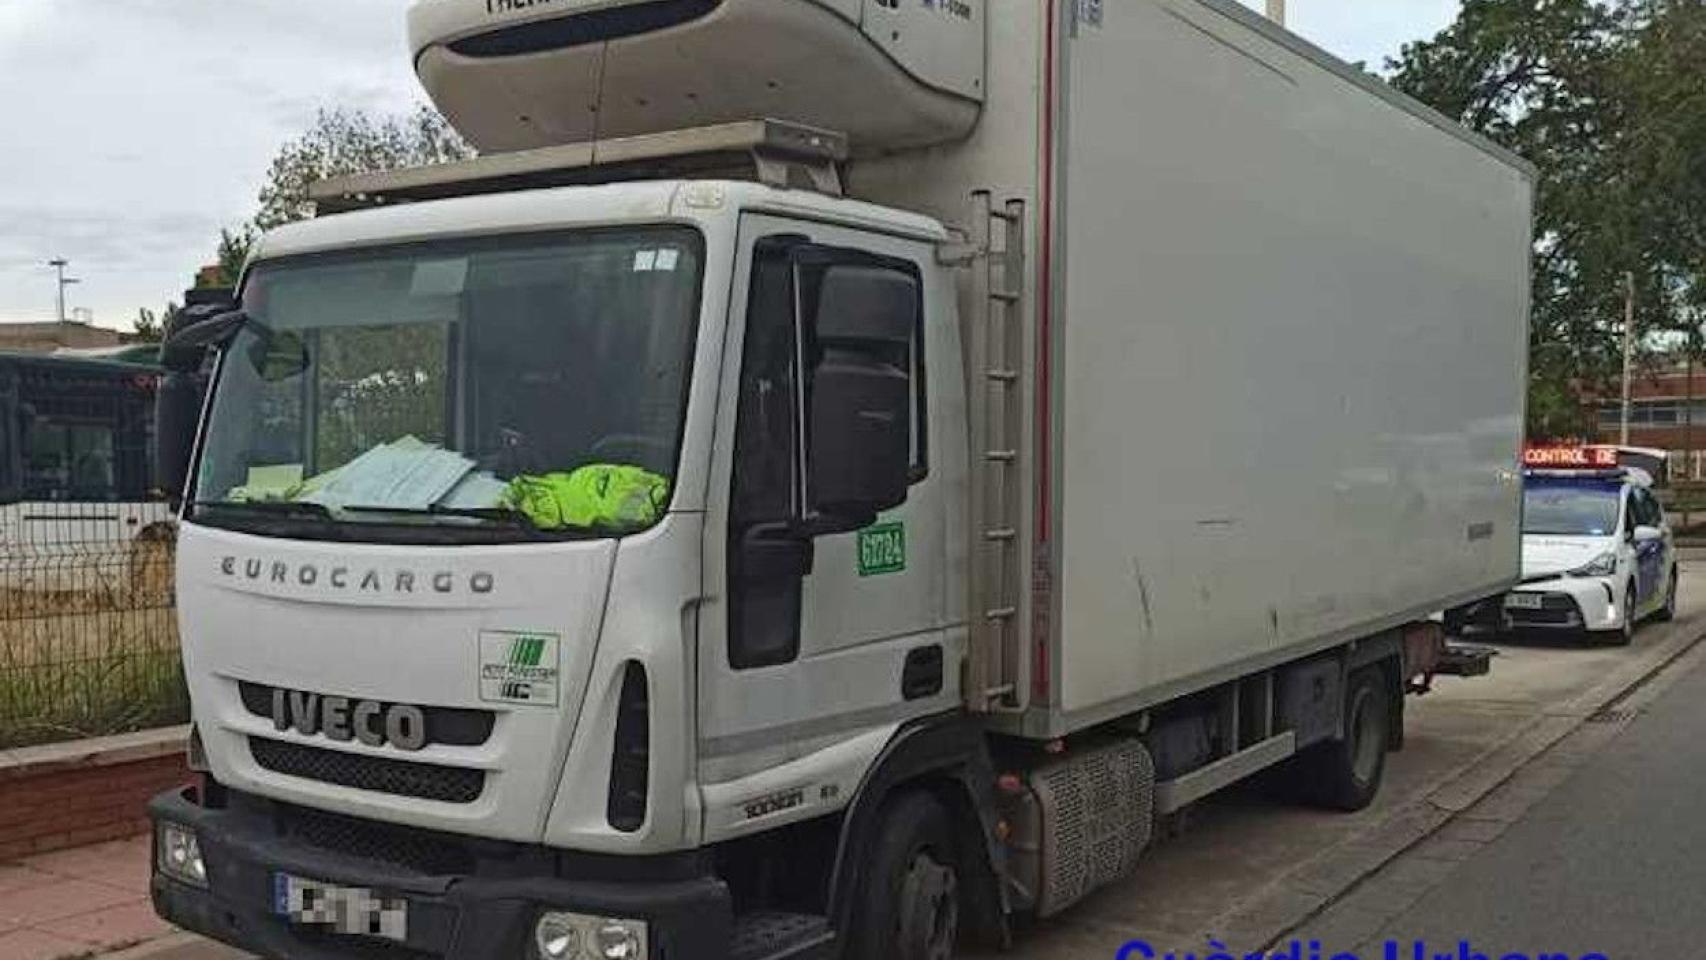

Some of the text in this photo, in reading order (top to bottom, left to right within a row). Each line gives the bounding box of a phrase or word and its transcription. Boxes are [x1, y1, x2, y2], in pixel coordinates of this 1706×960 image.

[1525, 448, 1617, 464] CONTROL DE
[221, 556, 494, 593] EUROCARGO
[272, 689, 427, 751] IVECO
